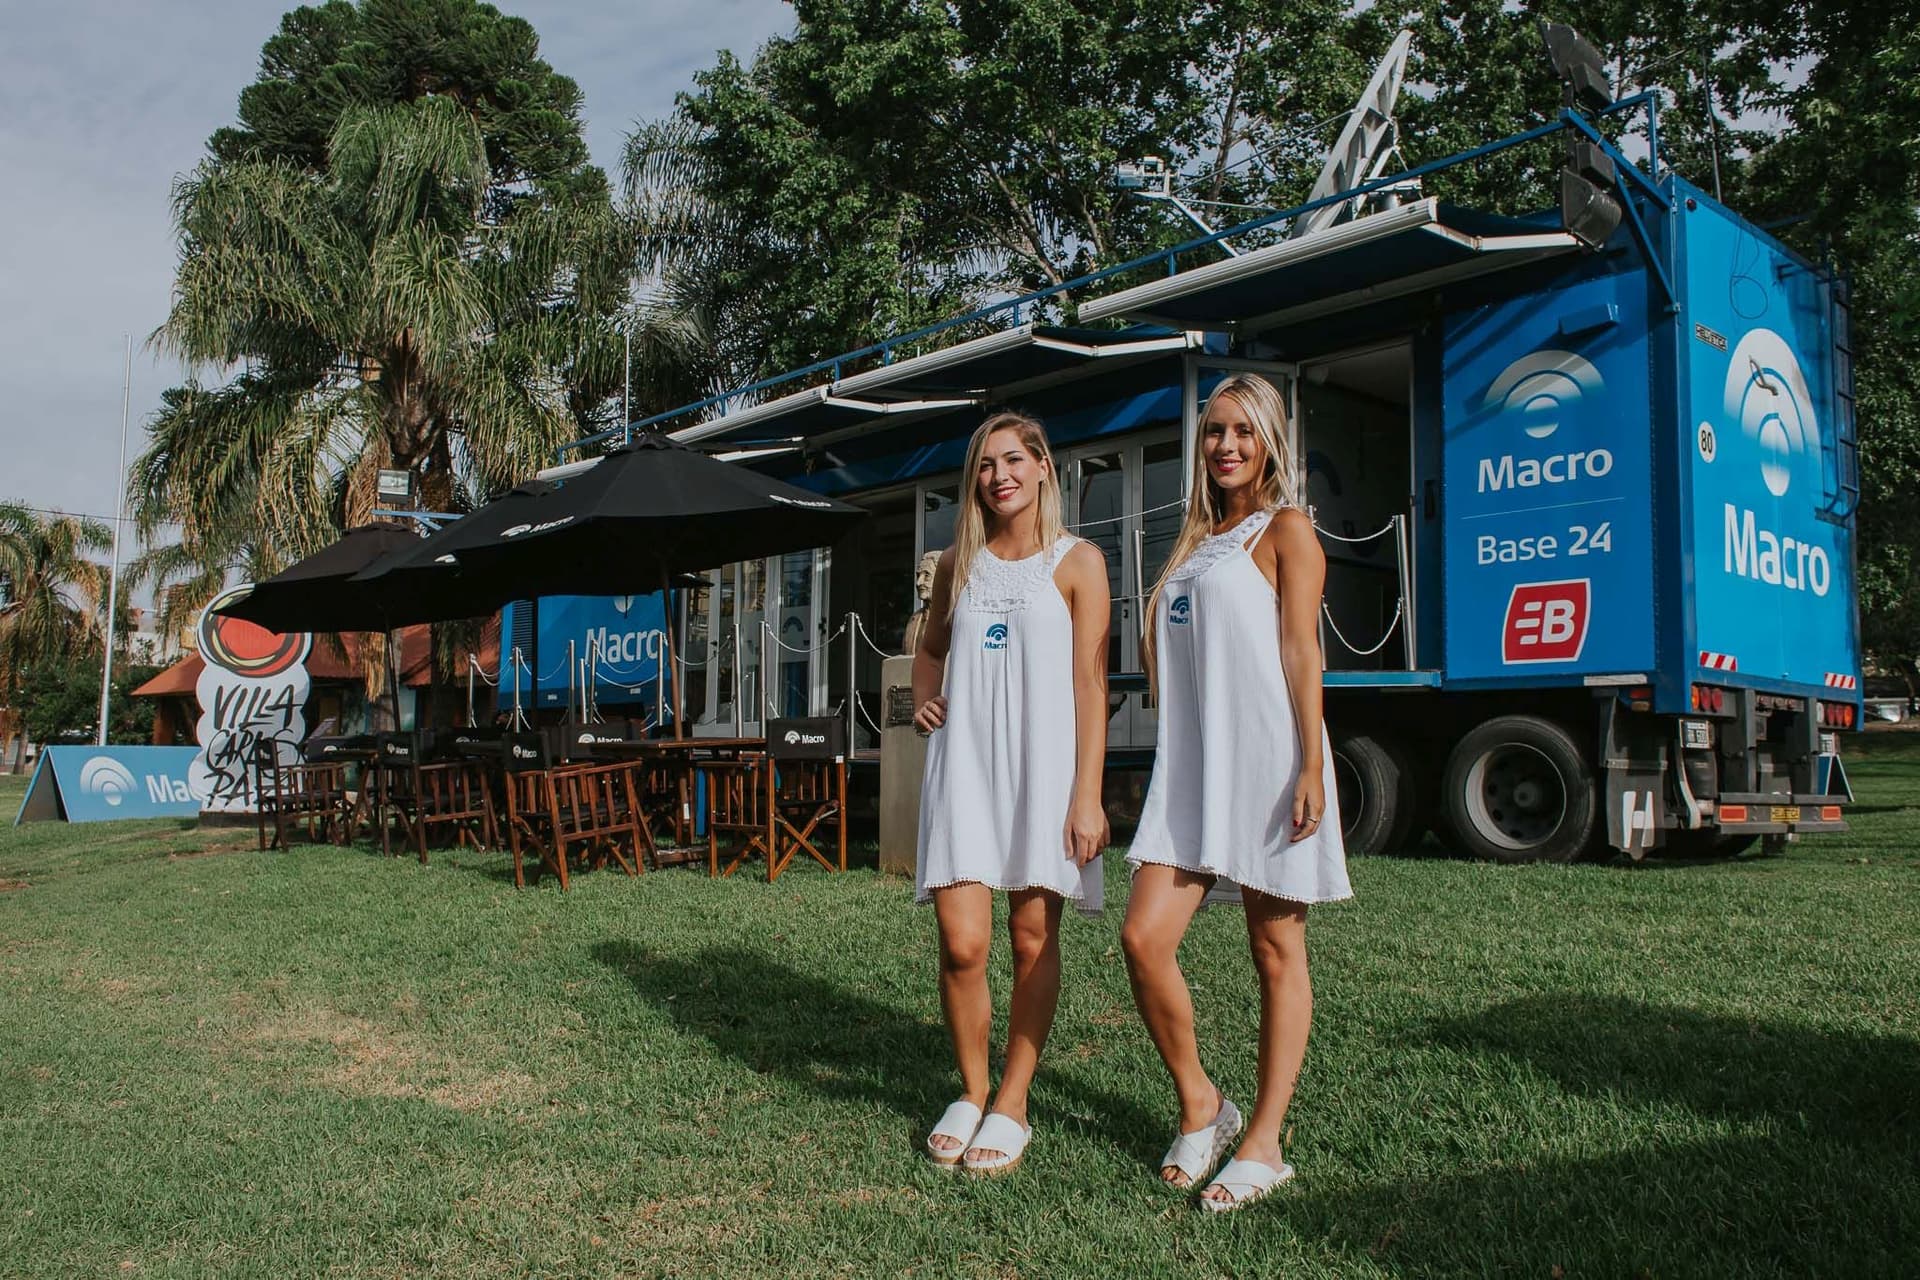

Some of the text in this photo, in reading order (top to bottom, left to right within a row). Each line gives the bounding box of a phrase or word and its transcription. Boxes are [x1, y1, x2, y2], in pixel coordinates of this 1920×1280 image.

[1701, 429, 1713, 454] 80
[1478, 448, 1613, 493] Macro
[1478, 521, 1612, 565] Base 24
[1724, 503, 1830, 597] Macro
[584, 627, 662, 665] Macro
[213, 683, 303, 731] VILLA
[206, 727, 301, 780] CARLS
[801, 734, 825, 744] Macro
